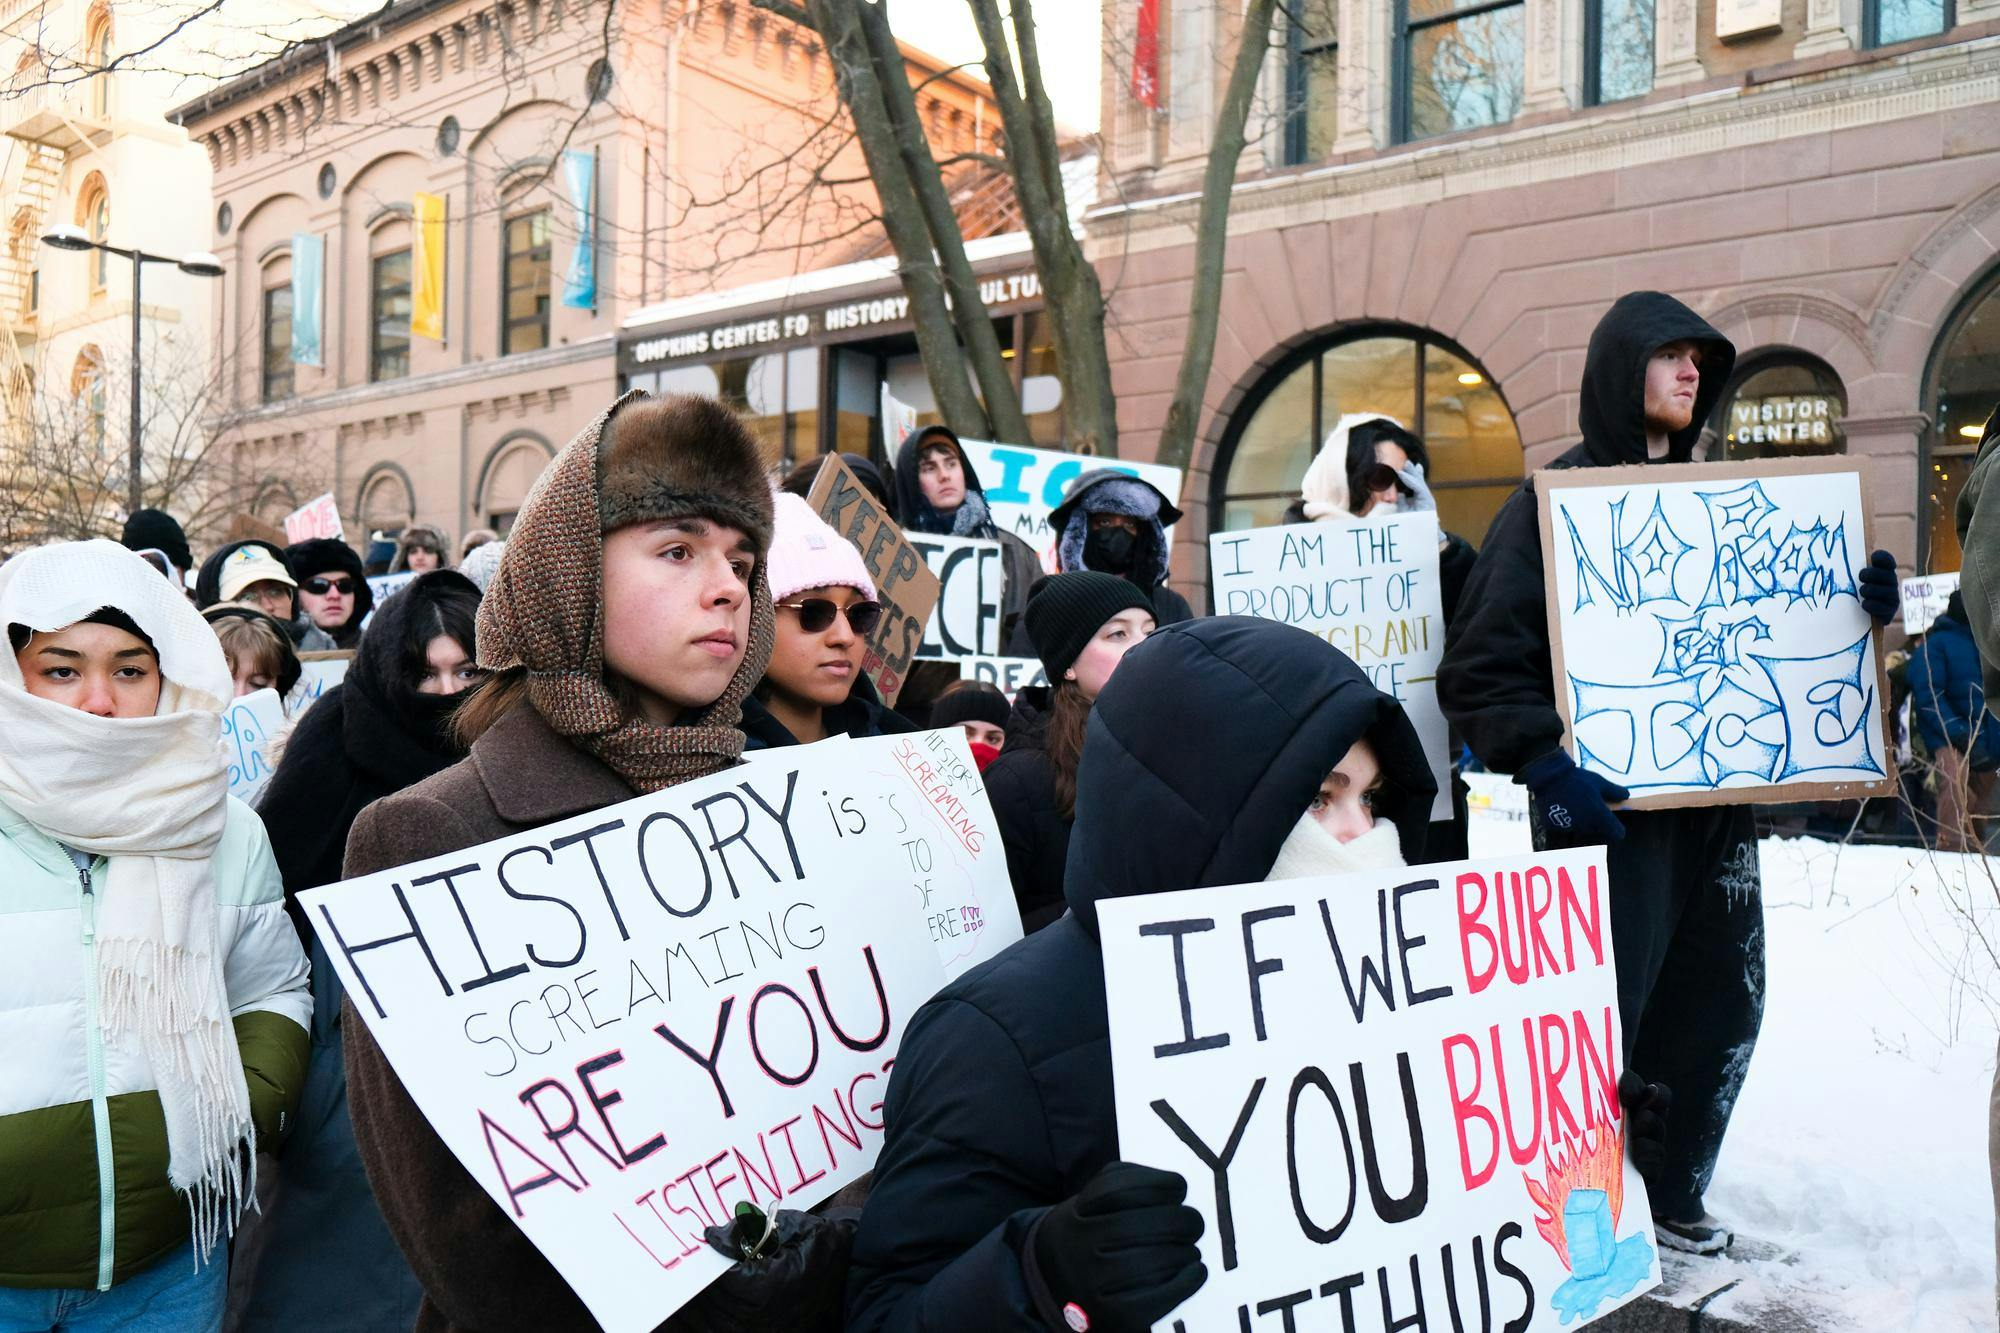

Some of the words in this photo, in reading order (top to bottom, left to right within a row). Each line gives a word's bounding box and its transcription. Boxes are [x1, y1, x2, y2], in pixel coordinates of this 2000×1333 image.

[631, 330, 709, 364] OMPKINS
[711, 318, 781, 353] CENTER
[783, 312, 821, 340] FO
[824, 296, 909, 332] HISTORY
[980, 273, 1043, 305] ULTU
[1737, 399, 1829, 424] VISITOR
[1737, 420, 1827, 445] CENTER
[819, 468, 918, 594] KEEP
[986, 448, 1140, 511] IC
[1014, 512, 1049, 537] MA
[1221, 538, 1254, 577] I
[1278, 532, 1324, 572] AM
[1346, 523, 1402, 567] THE
[1227, 576, 1373, 624] PRODUCT
[1386, 568, 1421, 613] OF
[1559, 489, 1699, 618] NO
[1566, 628, 1888, 791] ICE
[894, 738, 985, 853] SCREAMING
[924, 730, 984, 796] HISTORY
[318, 769, 806, 1020] HISTORY
[821, 789, 868, 838] is
[902, 838, 933, 873] TO
[463, 902, 826, 1078] SCREAMING
[1138, 905, 1296, 1059] IF
[1317, 878, 1454, 1025] WE
[1455, 865, 1604, 995] BURN
[475, 1047, 669, 1219] ARE
[652, 944, 891, 1120] YOU
[1149, 1051, 1429, 1271] YOU
[1441, 1006, 1623, 1193] BURN
